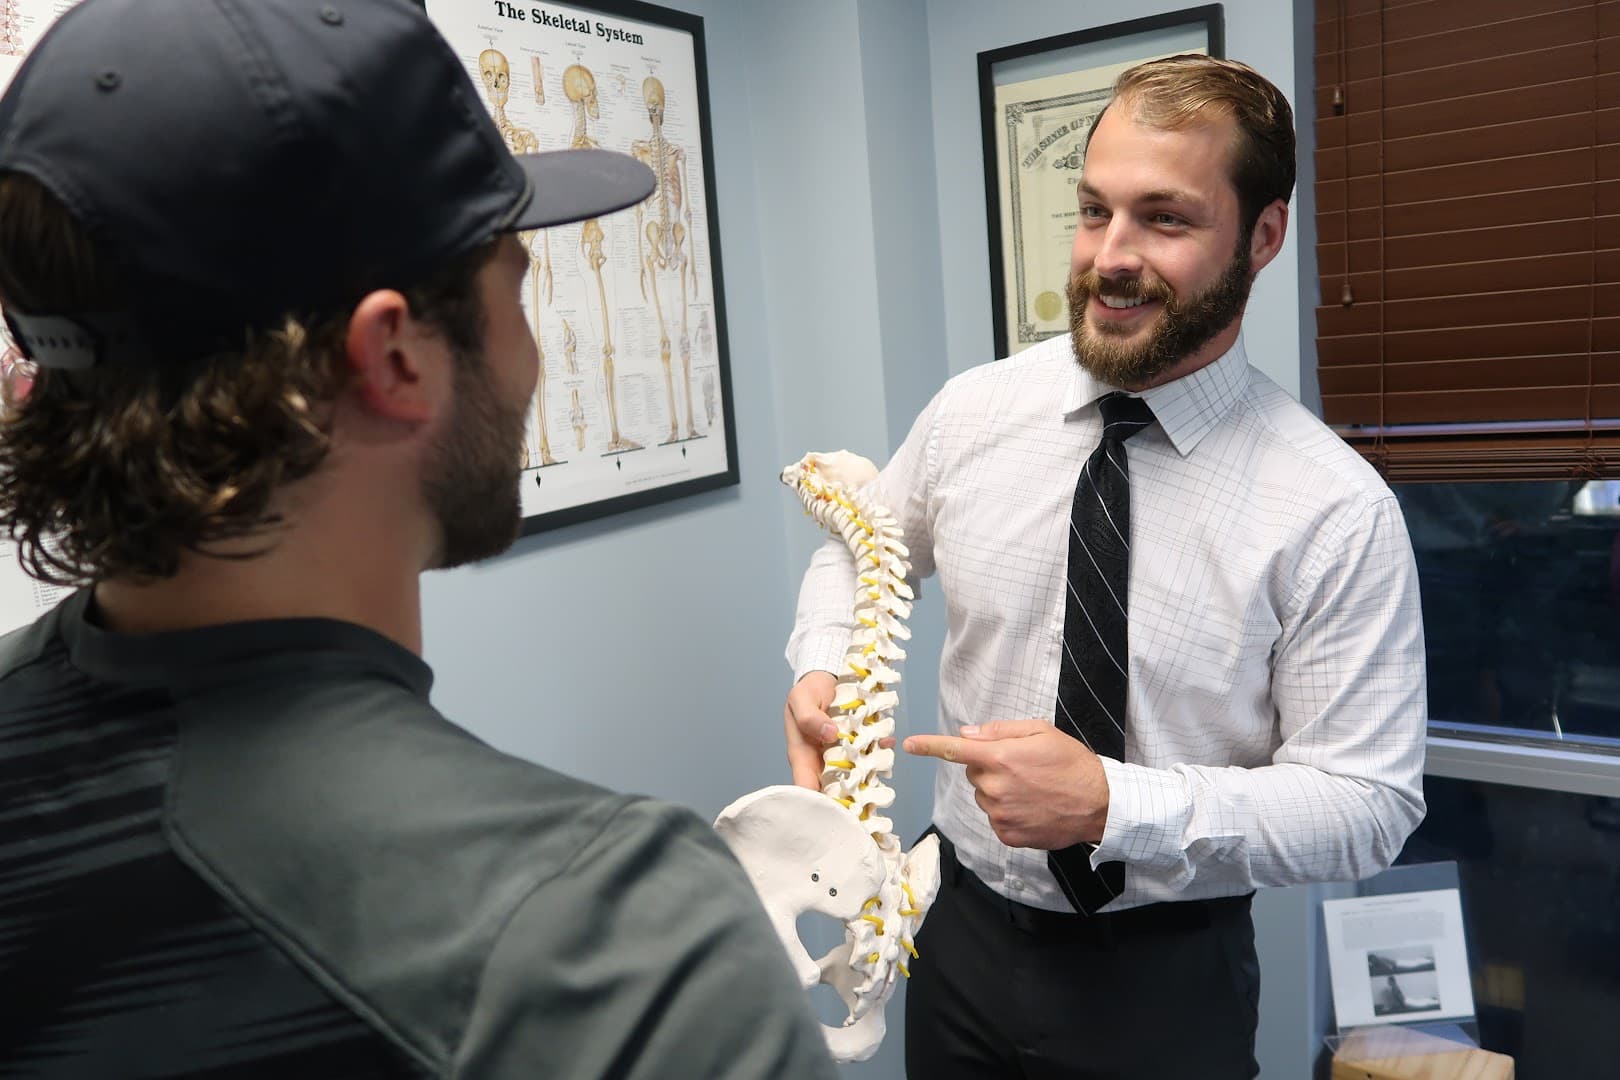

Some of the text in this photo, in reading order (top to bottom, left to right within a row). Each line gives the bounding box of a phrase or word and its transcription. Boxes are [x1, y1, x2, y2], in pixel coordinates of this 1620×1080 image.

[495, 0, 644, 45] The Skeletal System
